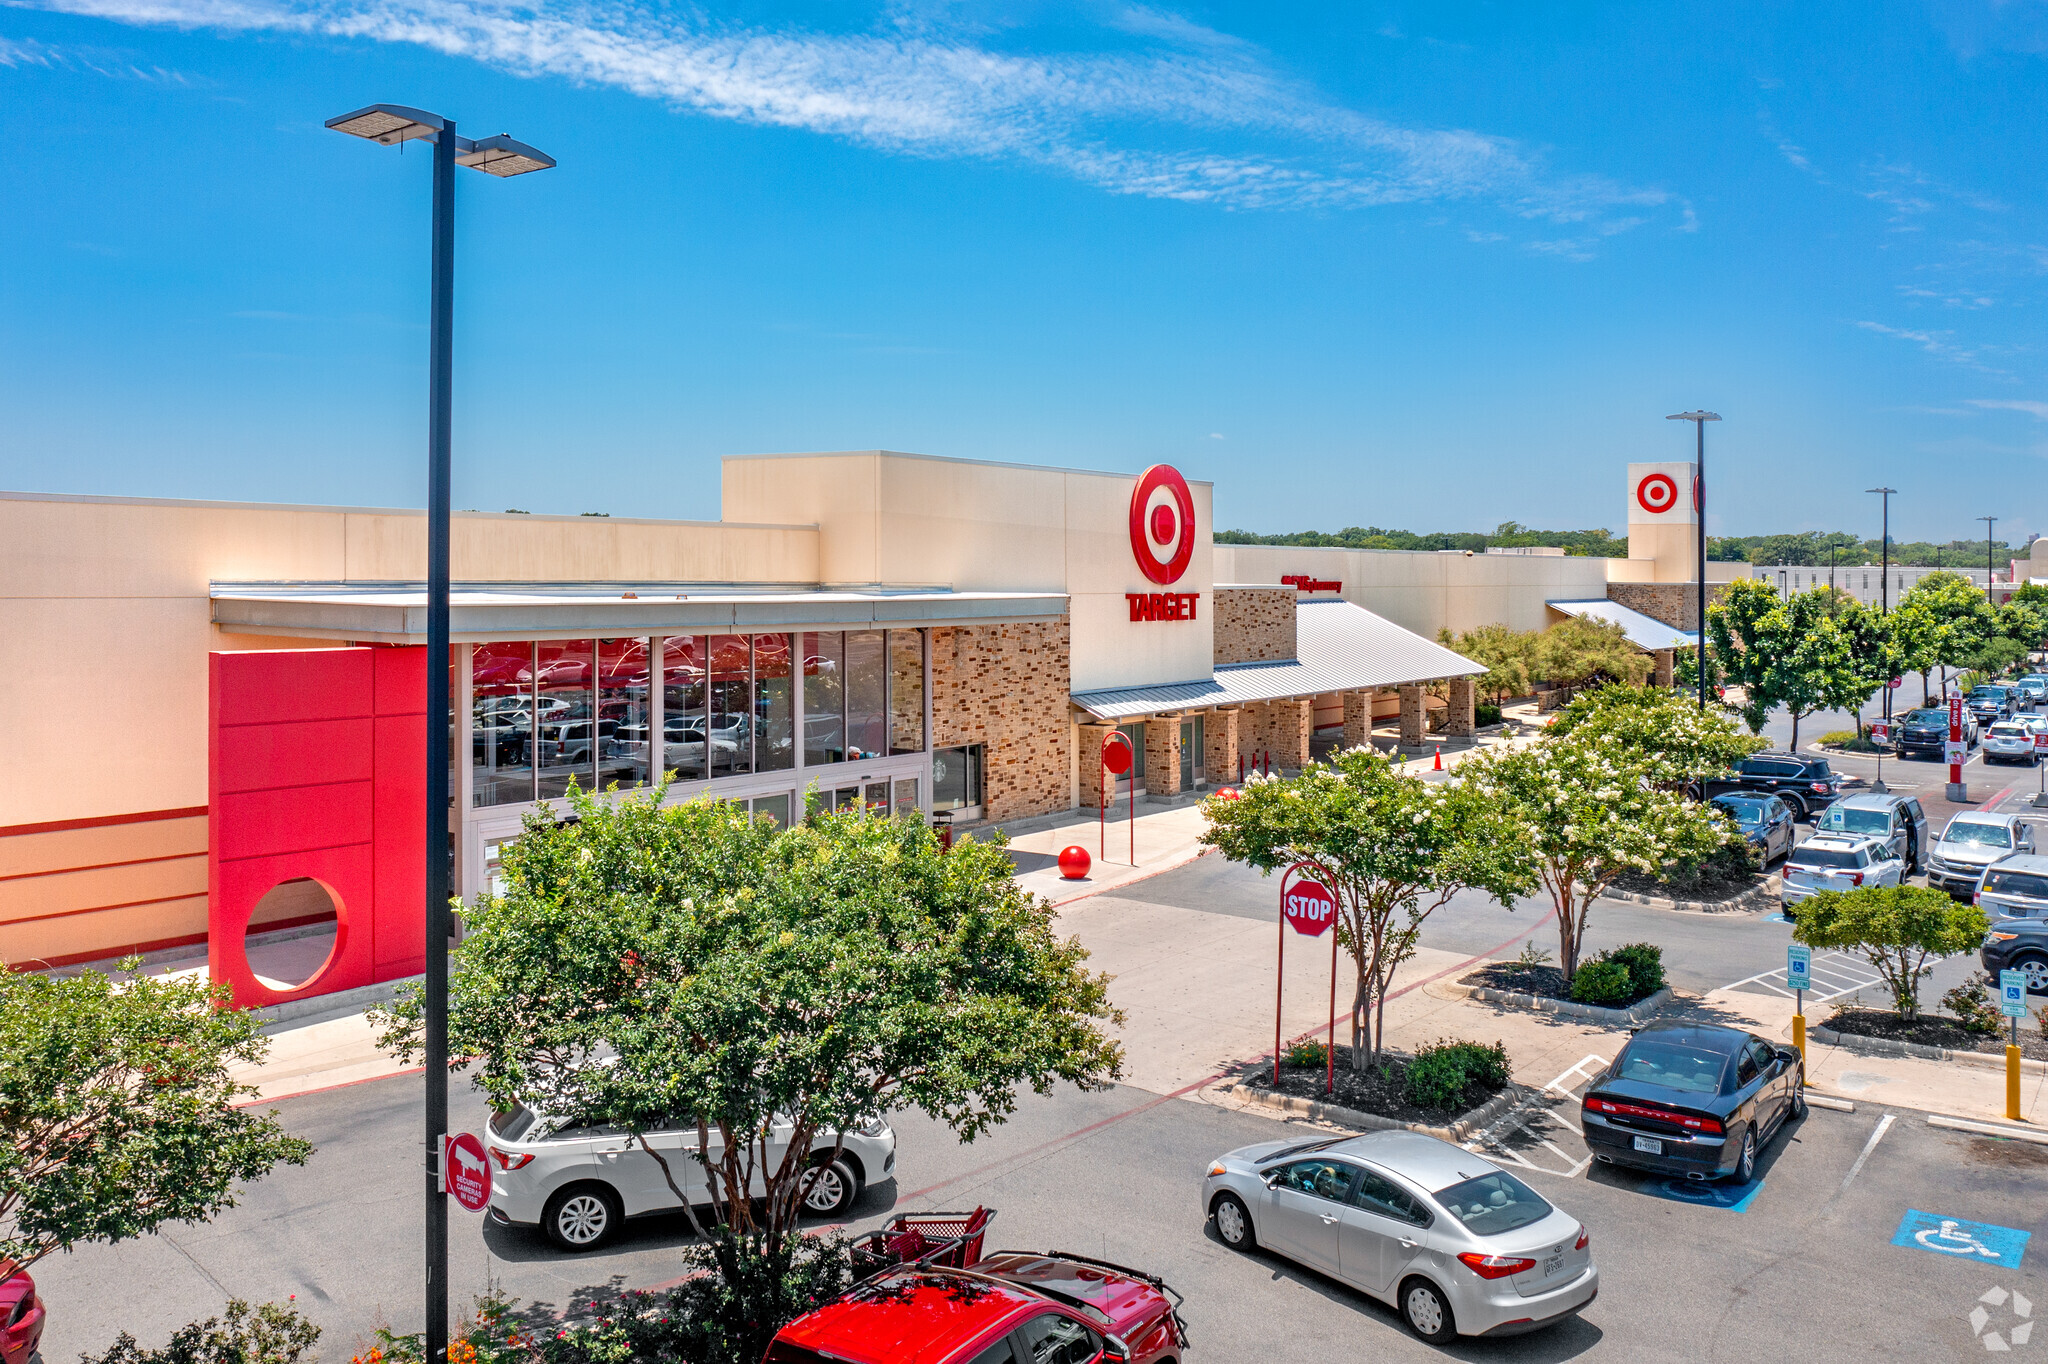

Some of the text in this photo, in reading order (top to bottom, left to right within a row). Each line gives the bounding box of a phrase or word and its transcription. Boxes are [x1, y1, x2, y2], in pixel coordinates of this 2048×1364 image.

[1126, 592, 1200, 622] TARGET
[1953, 700, 1960, 709] up
[1287, 894, 1331, 922] STOP
[456, 1174, 483, 1190] SECURITY
[456, 1182, 482, 1199] CAMERAS
[460, 1191, 479, 1205] IN USE
